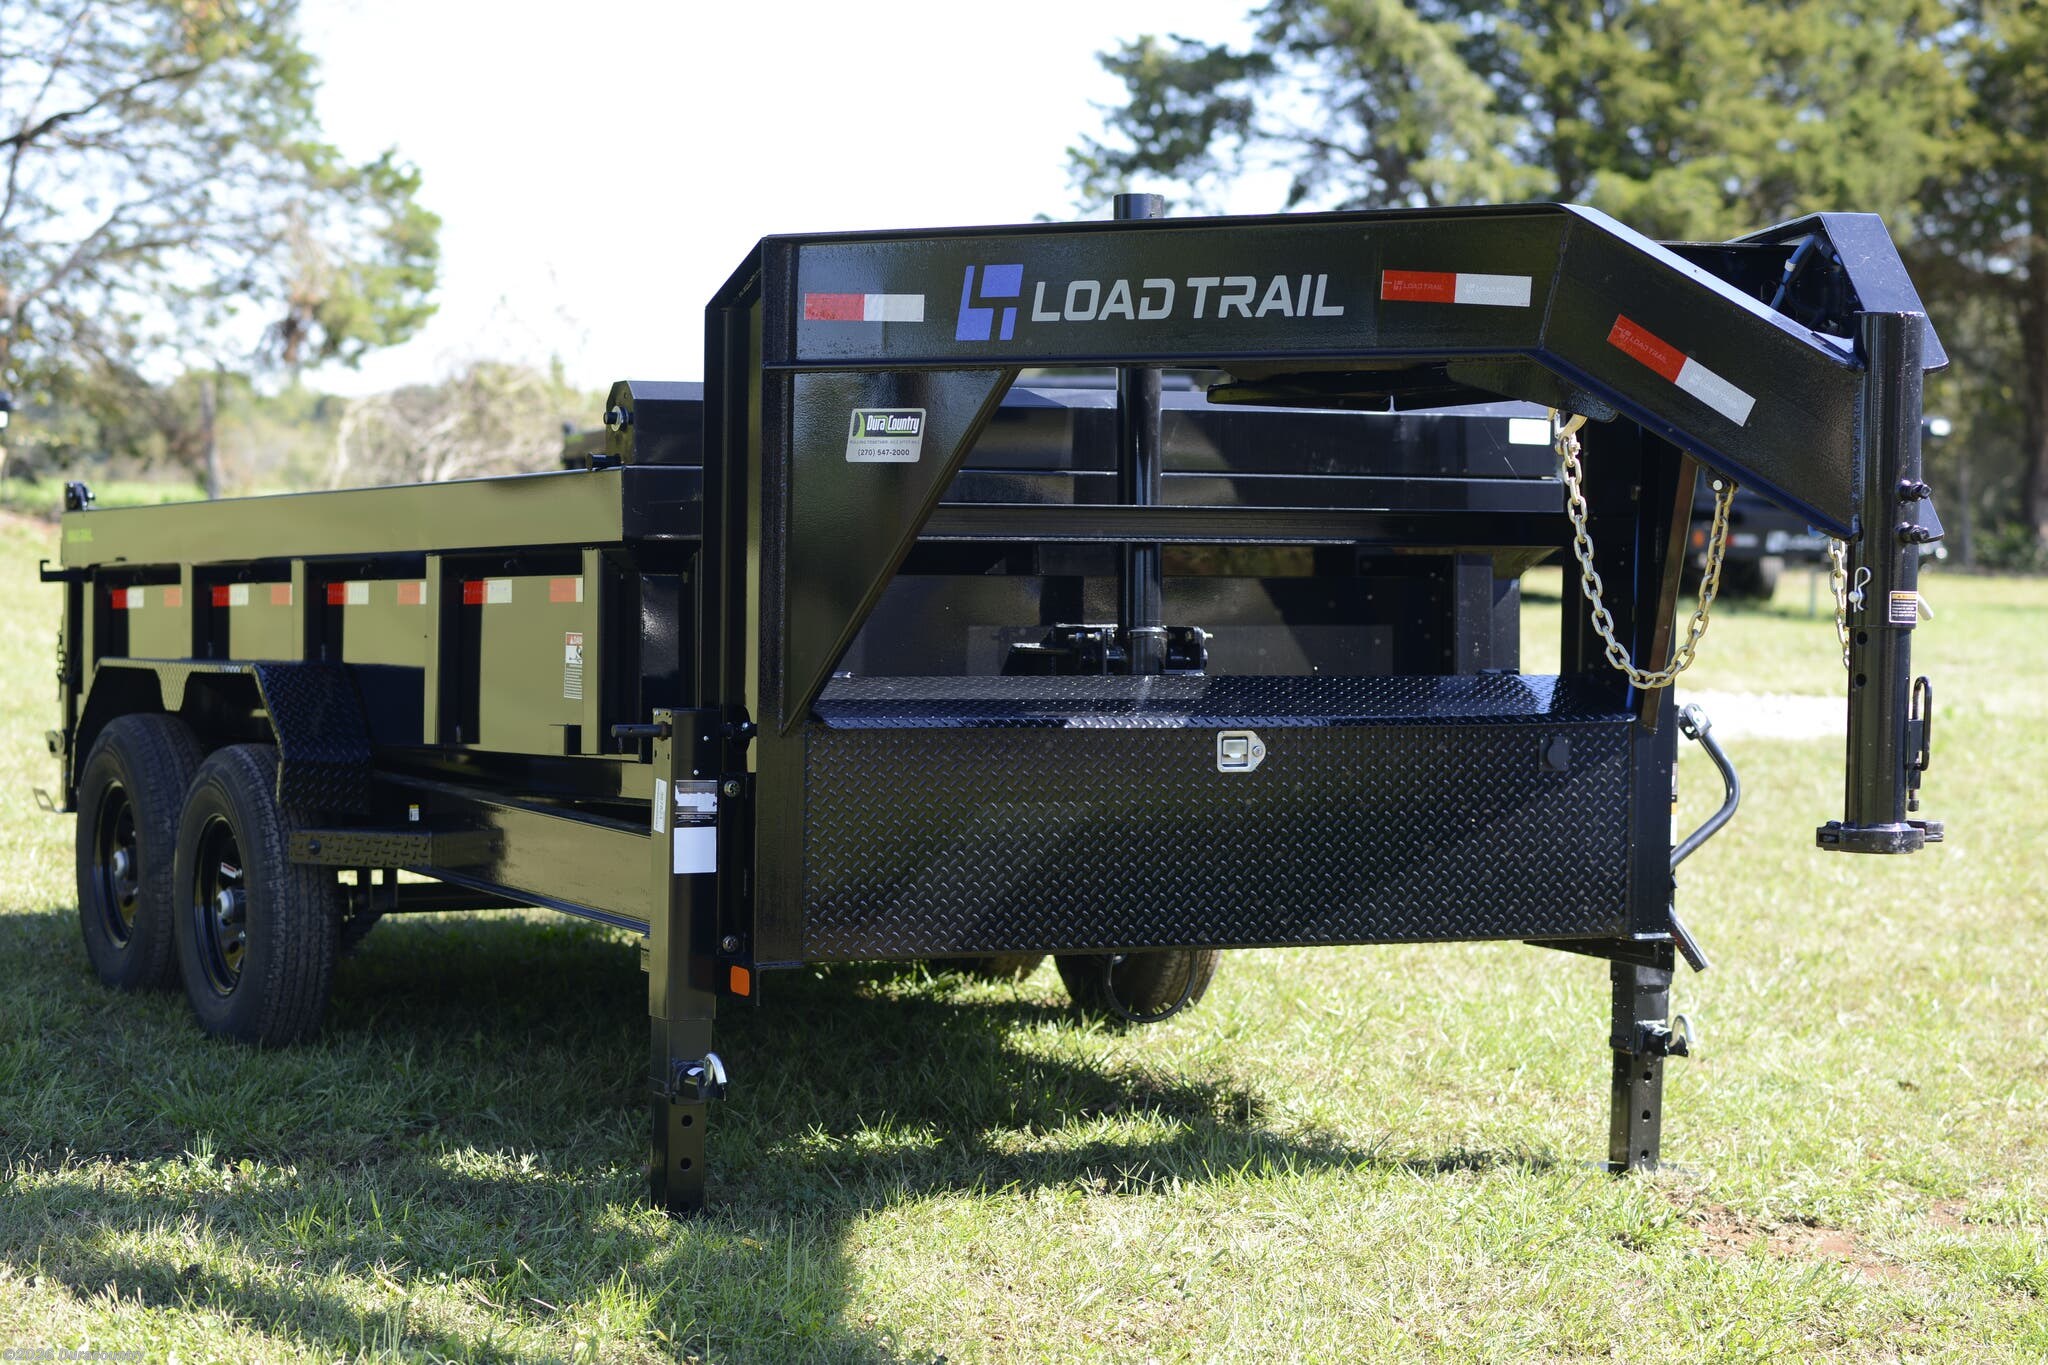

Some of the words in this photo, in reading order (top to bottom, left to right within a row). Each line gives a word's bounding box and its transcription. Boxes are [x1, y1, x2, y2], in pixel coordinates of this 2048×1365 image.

[1031, 278, 1176, 322] LOAD
[1186, 273, 1345, 320] TRAIL
[866, 415, 886, 431] Dura
[888, 415, 920, 434] Country
[857, 448, 876, 457] (270)
[877, 448, 910, 456] 547-2000
